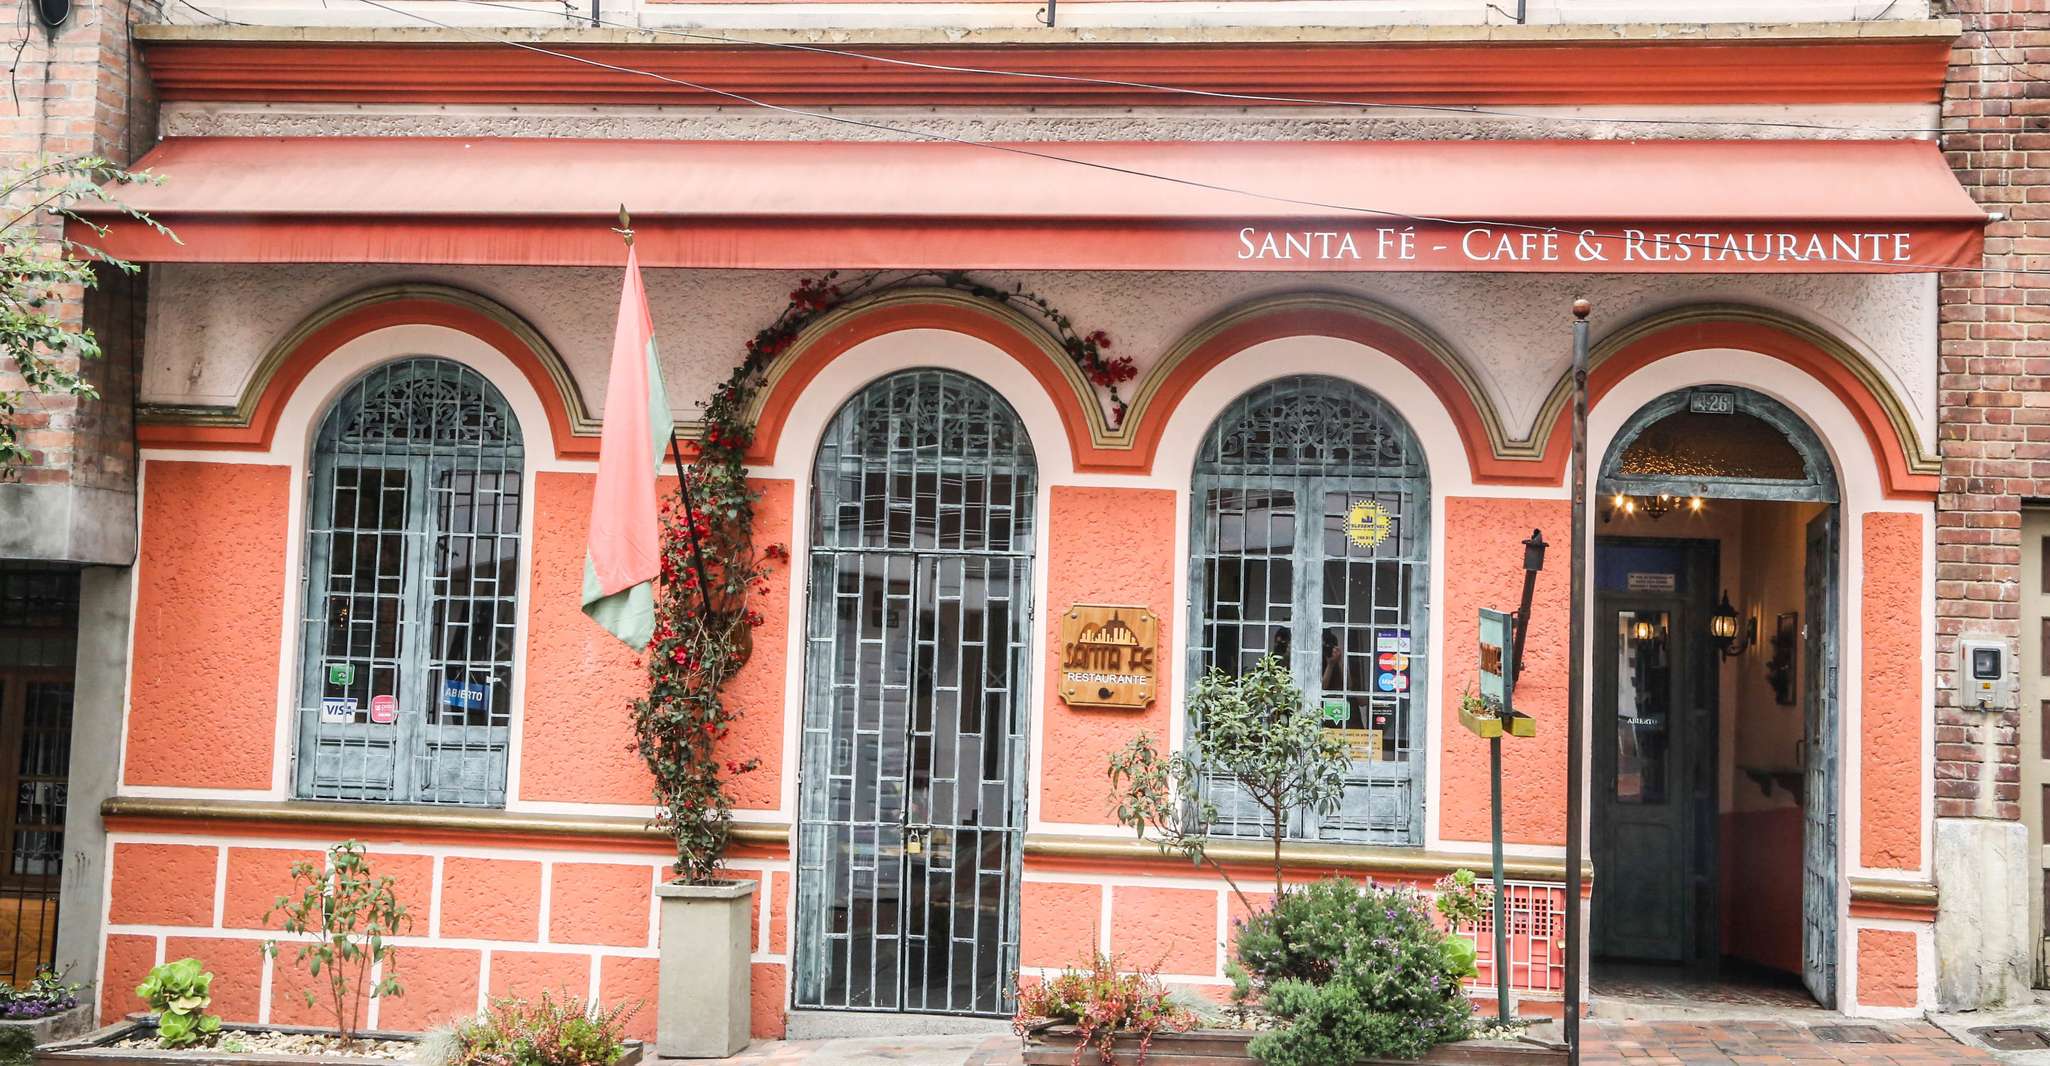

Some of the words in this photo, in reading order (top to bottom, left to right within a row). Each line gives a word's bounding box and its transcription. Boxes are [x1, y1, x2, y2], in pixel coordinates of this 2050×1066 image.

[1237, 227, 1361, 260] SANTA
[1376, 226, 1416, 260] FÉ
[1462, 227, 1560, 261] CAFÉ
[1574, 229, 1608, 261] &
[1623, 229, 1911, 261] RESTAURANTE
[1067, 672, 1147, 684] RESTAURANTE
[445, 687, 483, 702] ABIERTO
